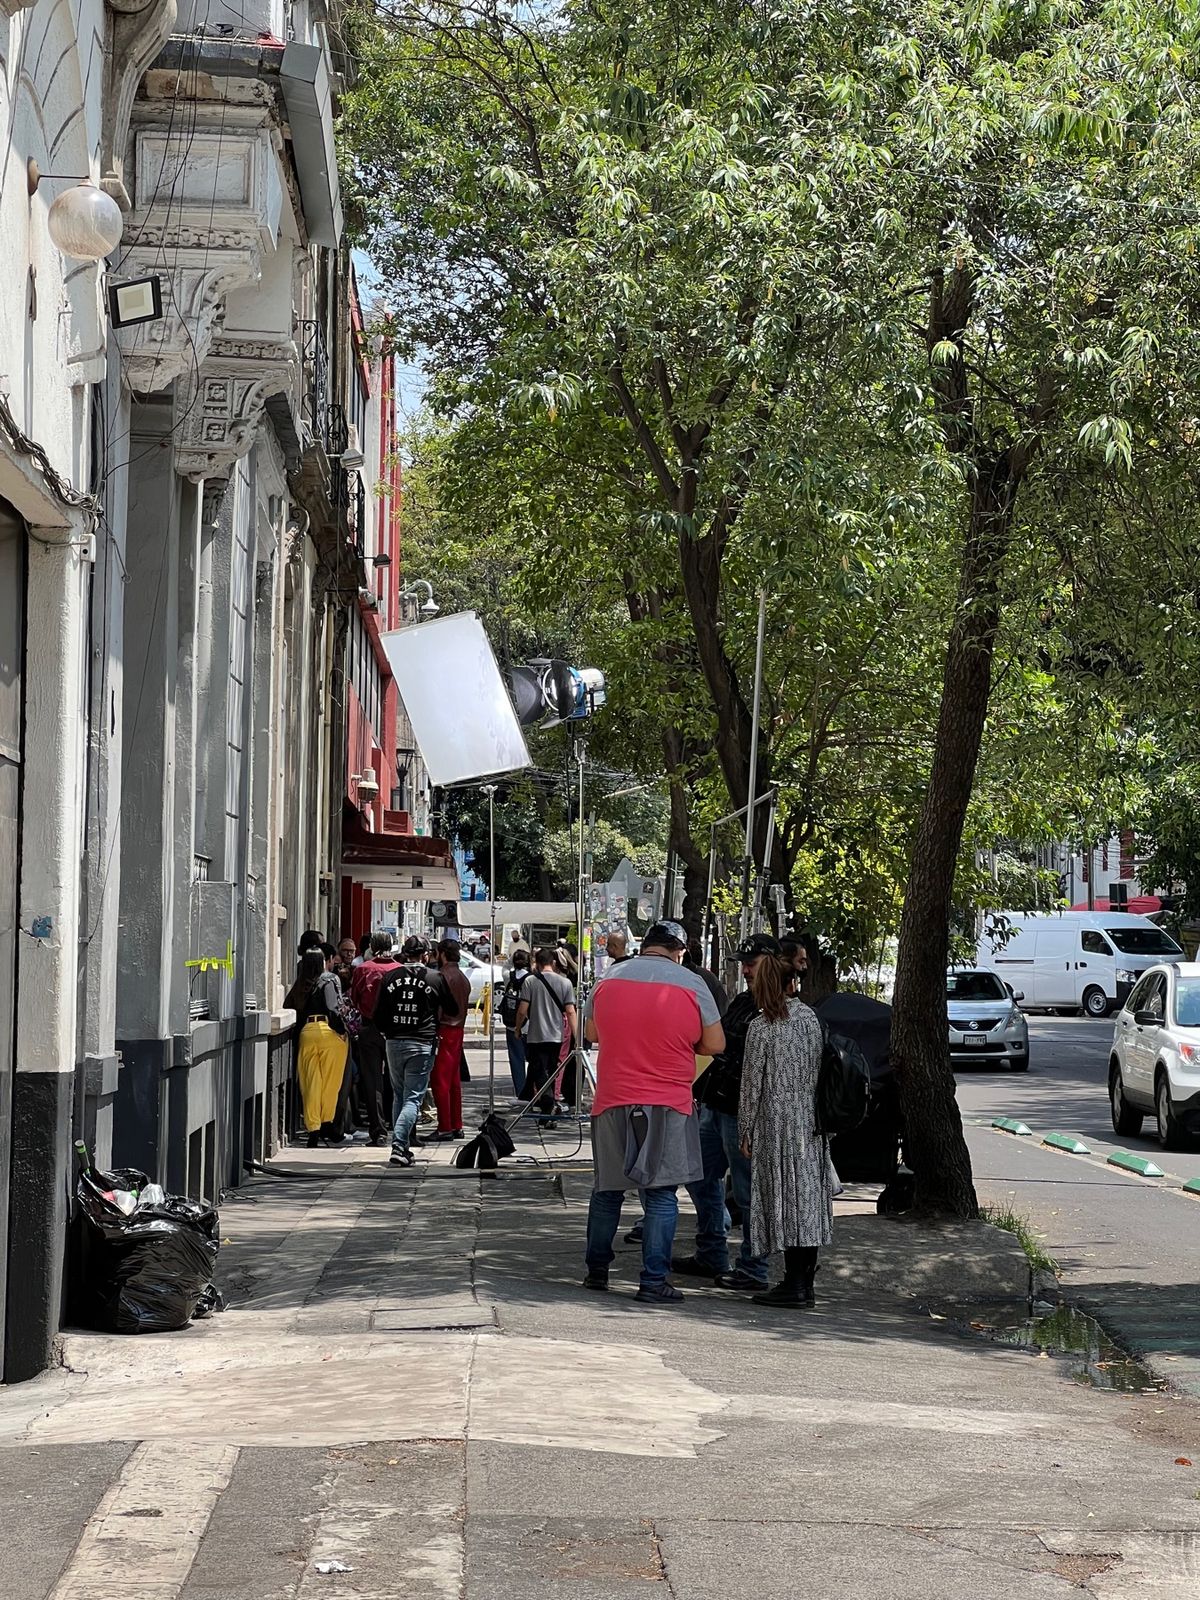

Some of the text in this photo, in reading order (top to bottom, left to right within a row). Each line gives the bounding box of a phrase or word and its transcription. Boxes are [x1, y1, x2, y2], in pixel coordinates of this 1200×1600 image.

[387, 977, 432, 994] MEXICO
[402, 991, 414, 999] IS
[397, 1003, 417, 1012] THE
[393, 1015, 419, 1025] SHIT
